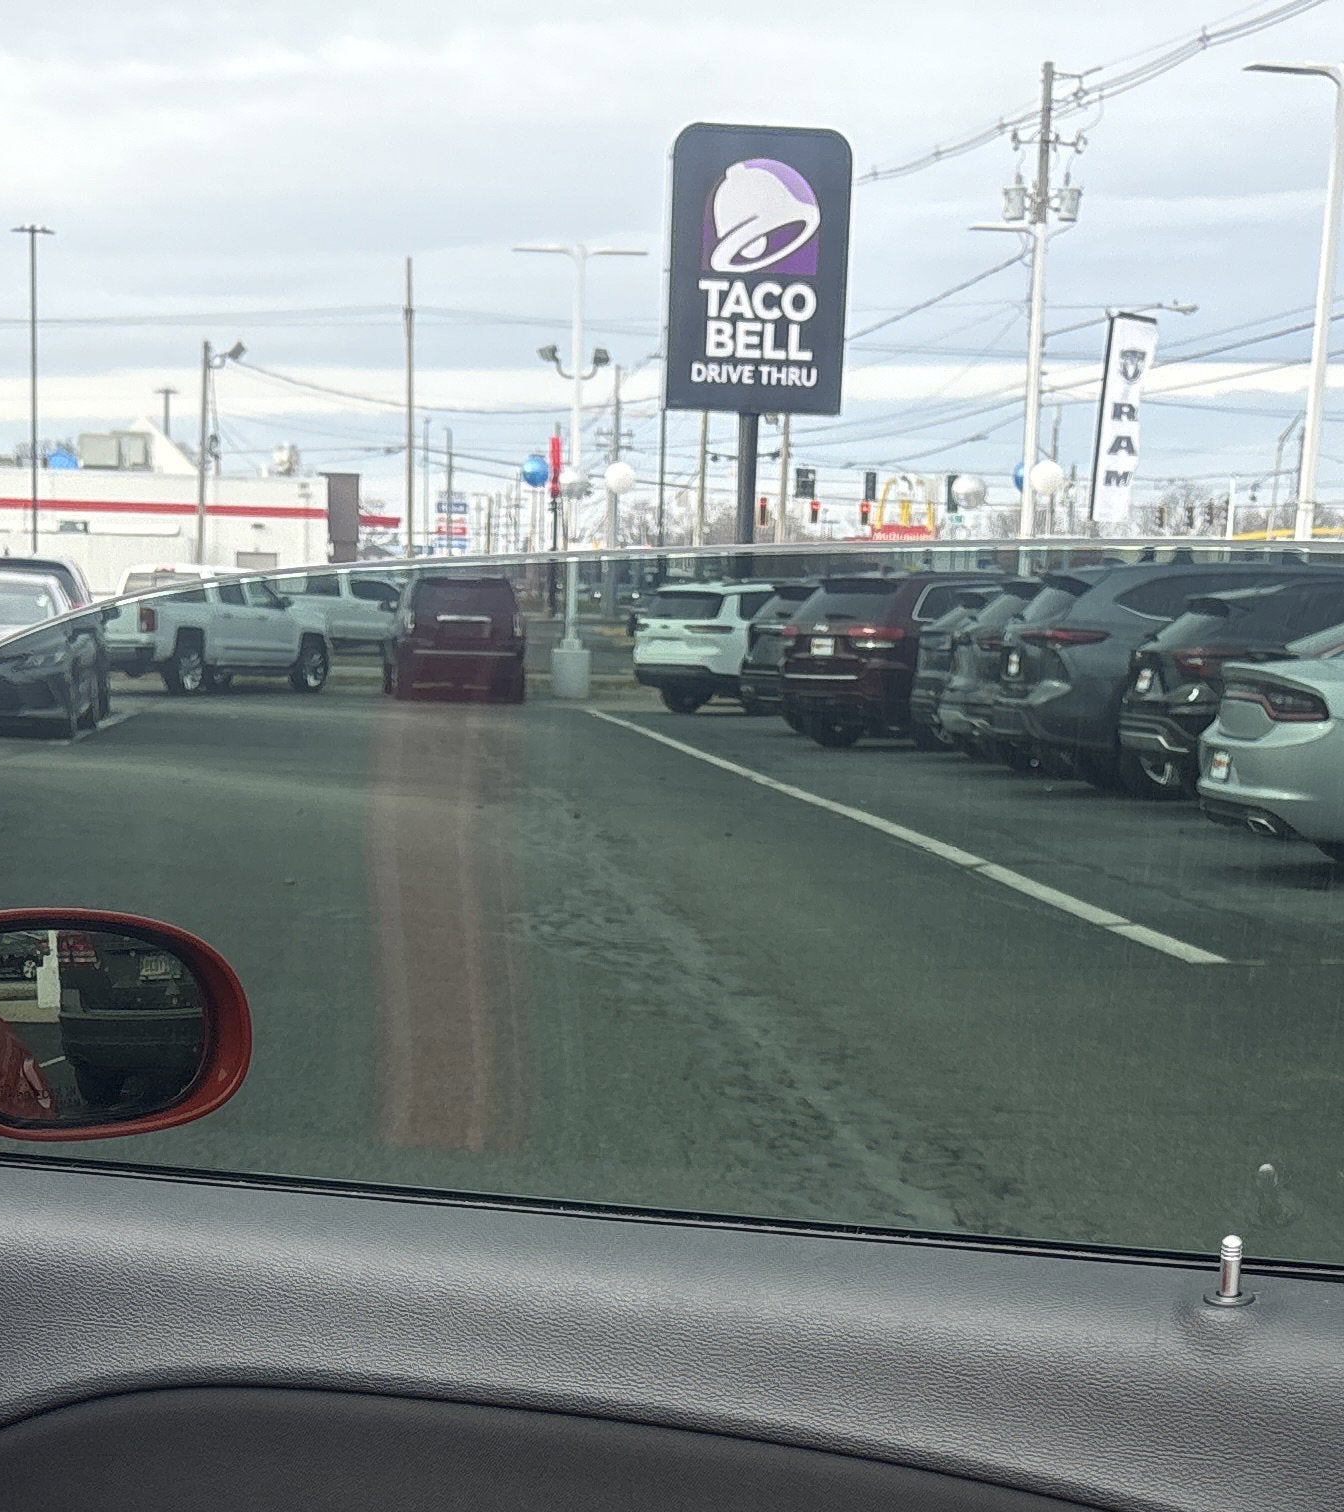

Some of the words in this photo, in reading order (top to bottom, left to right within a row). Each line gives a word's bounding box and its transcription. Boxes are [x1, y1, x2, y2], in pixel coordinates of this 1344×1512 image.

[698, 279, 817, 322] TACO
[705, 319, 813, 362] BELL
[690, 360, 755, 385] DRIVE
[758, 364, 818, 388] THRU
[1104, 402, 1139, 487] RAM
